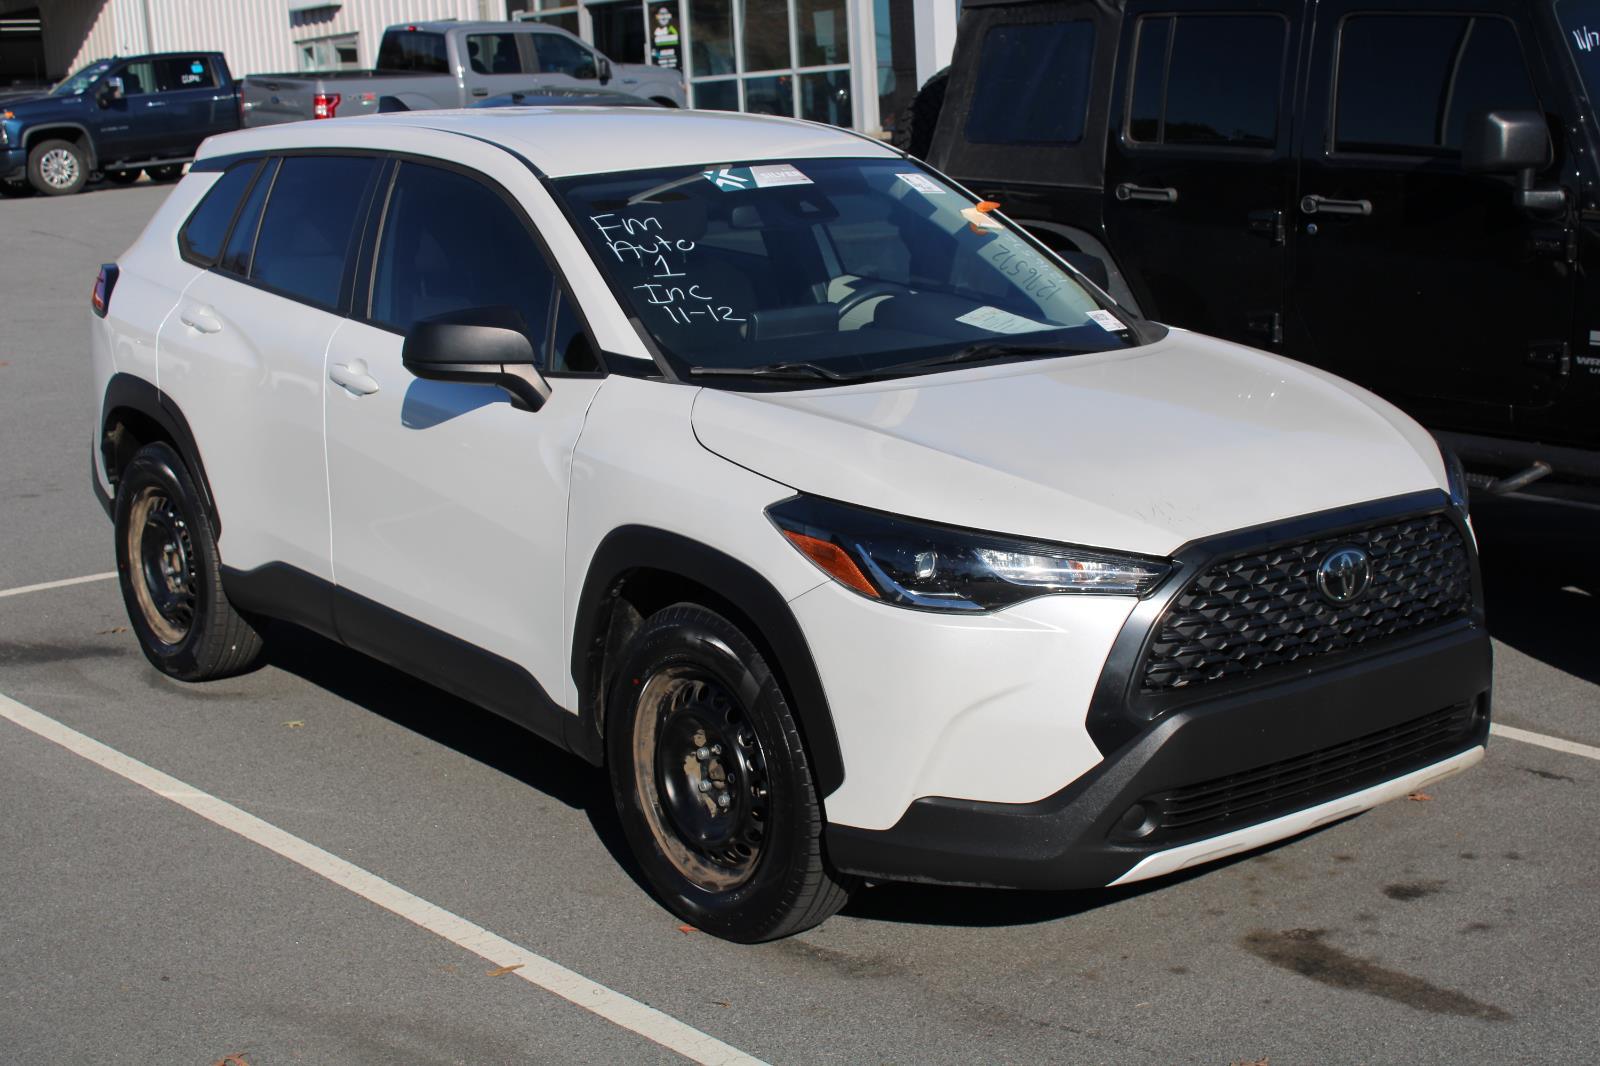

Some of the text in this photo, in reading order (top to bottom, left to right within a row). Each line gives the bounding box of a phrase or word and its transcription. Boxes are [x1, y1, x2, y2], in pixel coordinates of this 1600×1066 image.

[606, 235, 695, 262] Auto
[633, 284, 712, 304] Inc
[663, 304, 747, 324] 11-12
